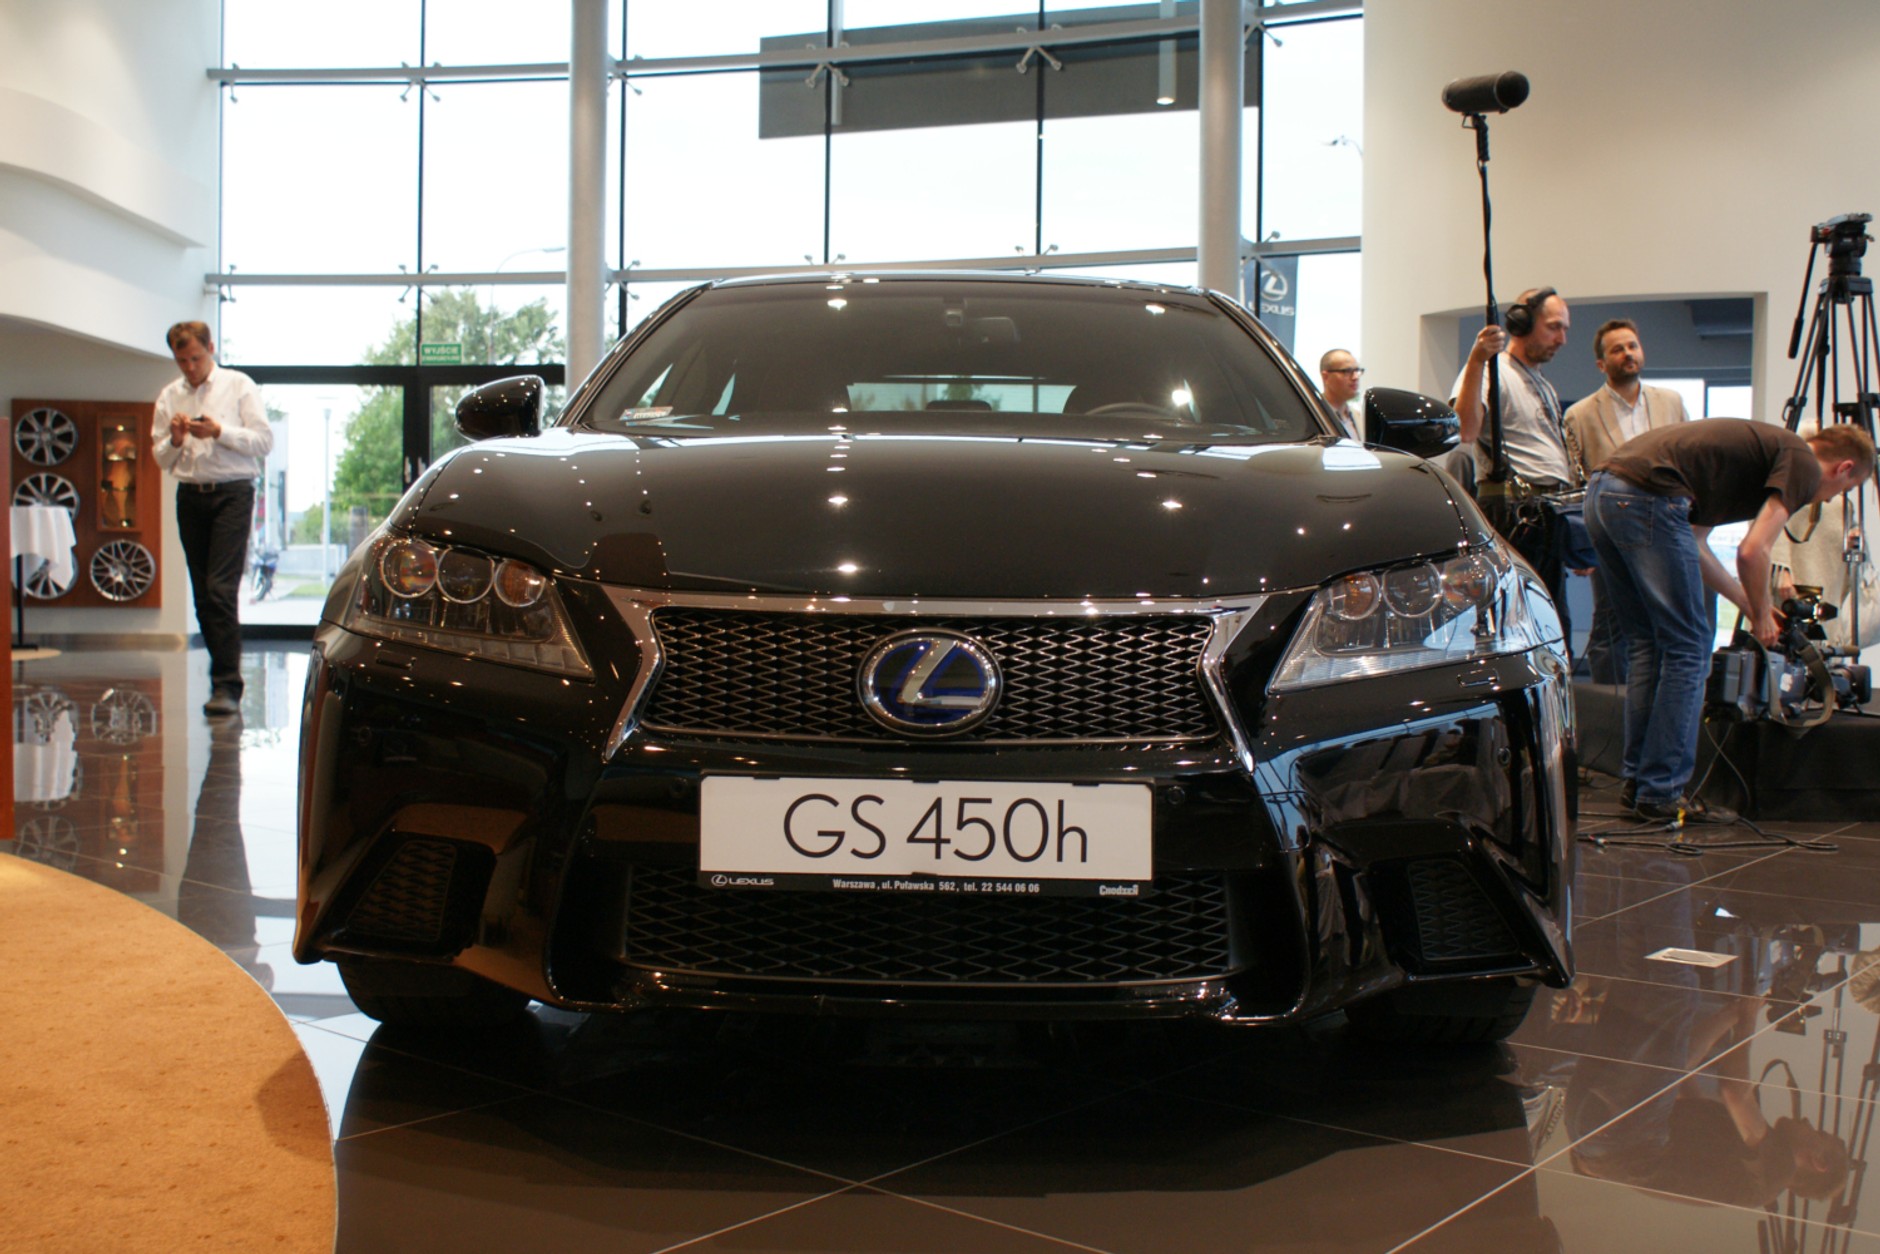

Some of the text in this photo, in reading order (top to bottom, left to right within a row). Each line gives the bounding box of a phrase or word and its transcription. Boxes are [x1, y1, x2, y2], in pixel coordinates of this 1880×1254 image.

[783, 793, 1088, 863] GS 450h
[728, 877, 775, 886] LEXUS
[881, 880, 893, 890] ul.
[893, 880, 935, 891] Puławska
[963, 881, 978, 892] tel.
[981, 882, 993, 892] 22
[995, 882, 1013, 893] 544
[1014, 883, 1027, 893] 06
[1027, 883, 1040, 894] 06
